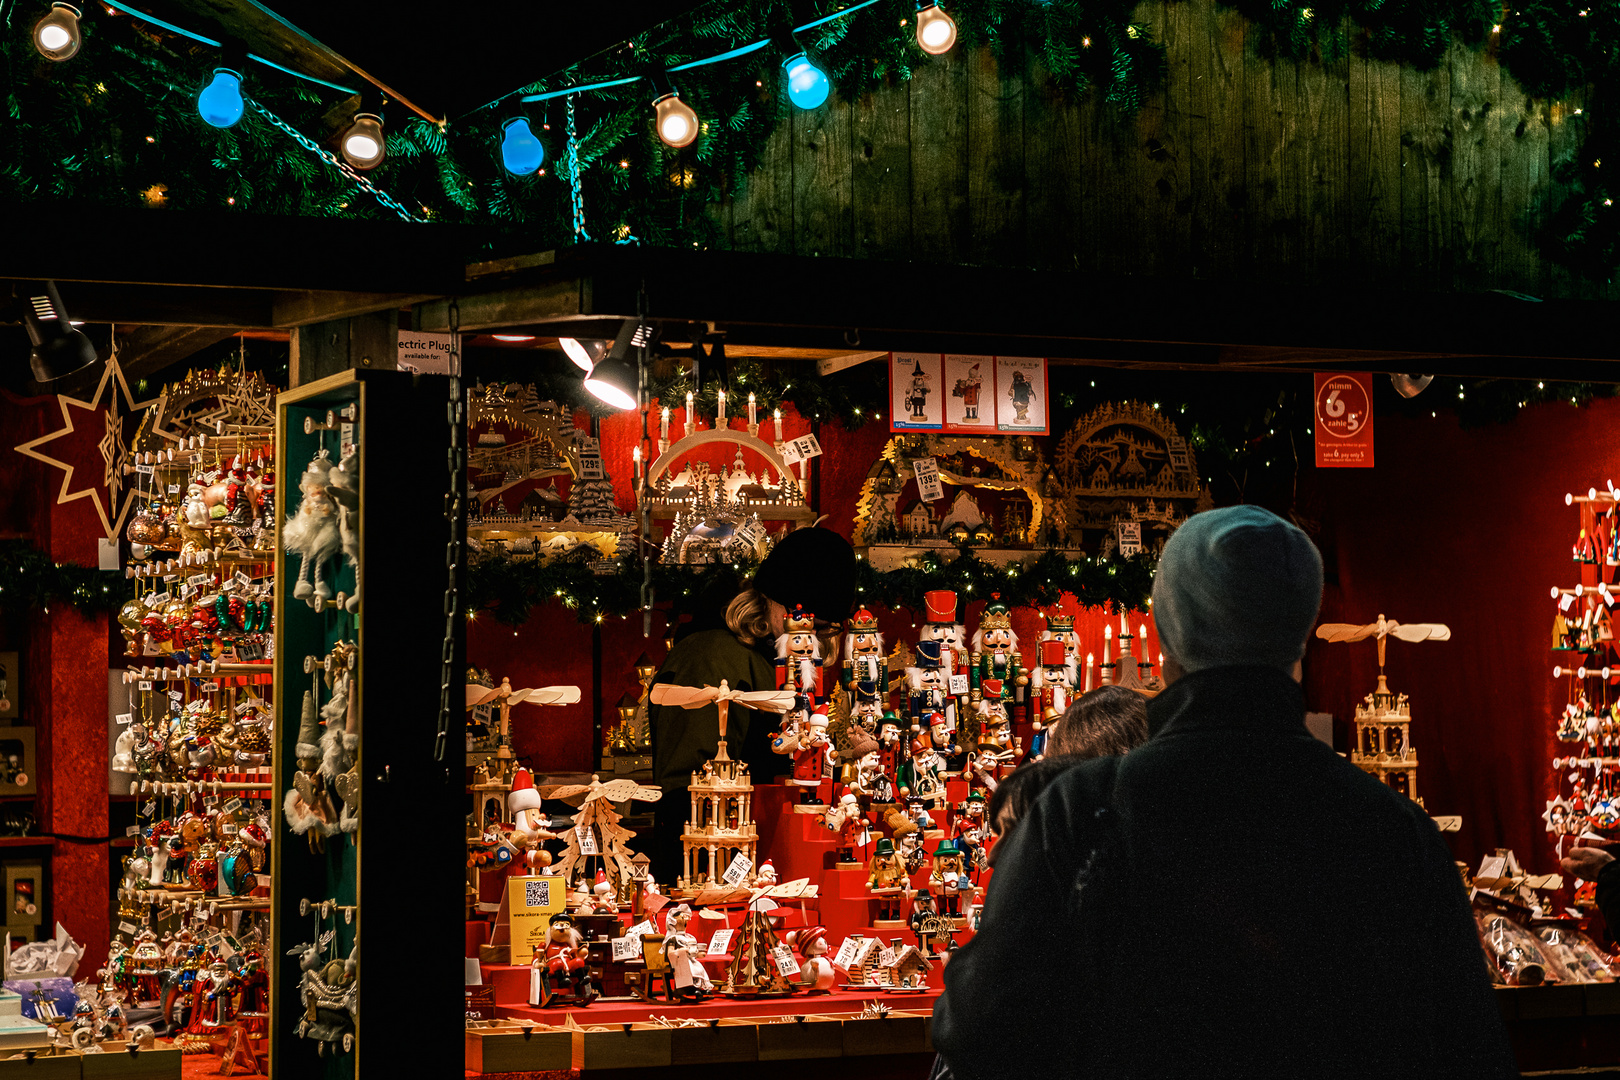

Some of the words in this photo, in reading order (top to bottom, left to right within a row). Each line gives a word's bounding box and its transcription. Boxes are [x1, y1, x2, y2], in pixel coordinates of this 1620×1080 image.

[429, 340, 455, 353] Plug
[1329, 382, 1352, 390] nimm
[1326, 390, 1346, 418] 6
